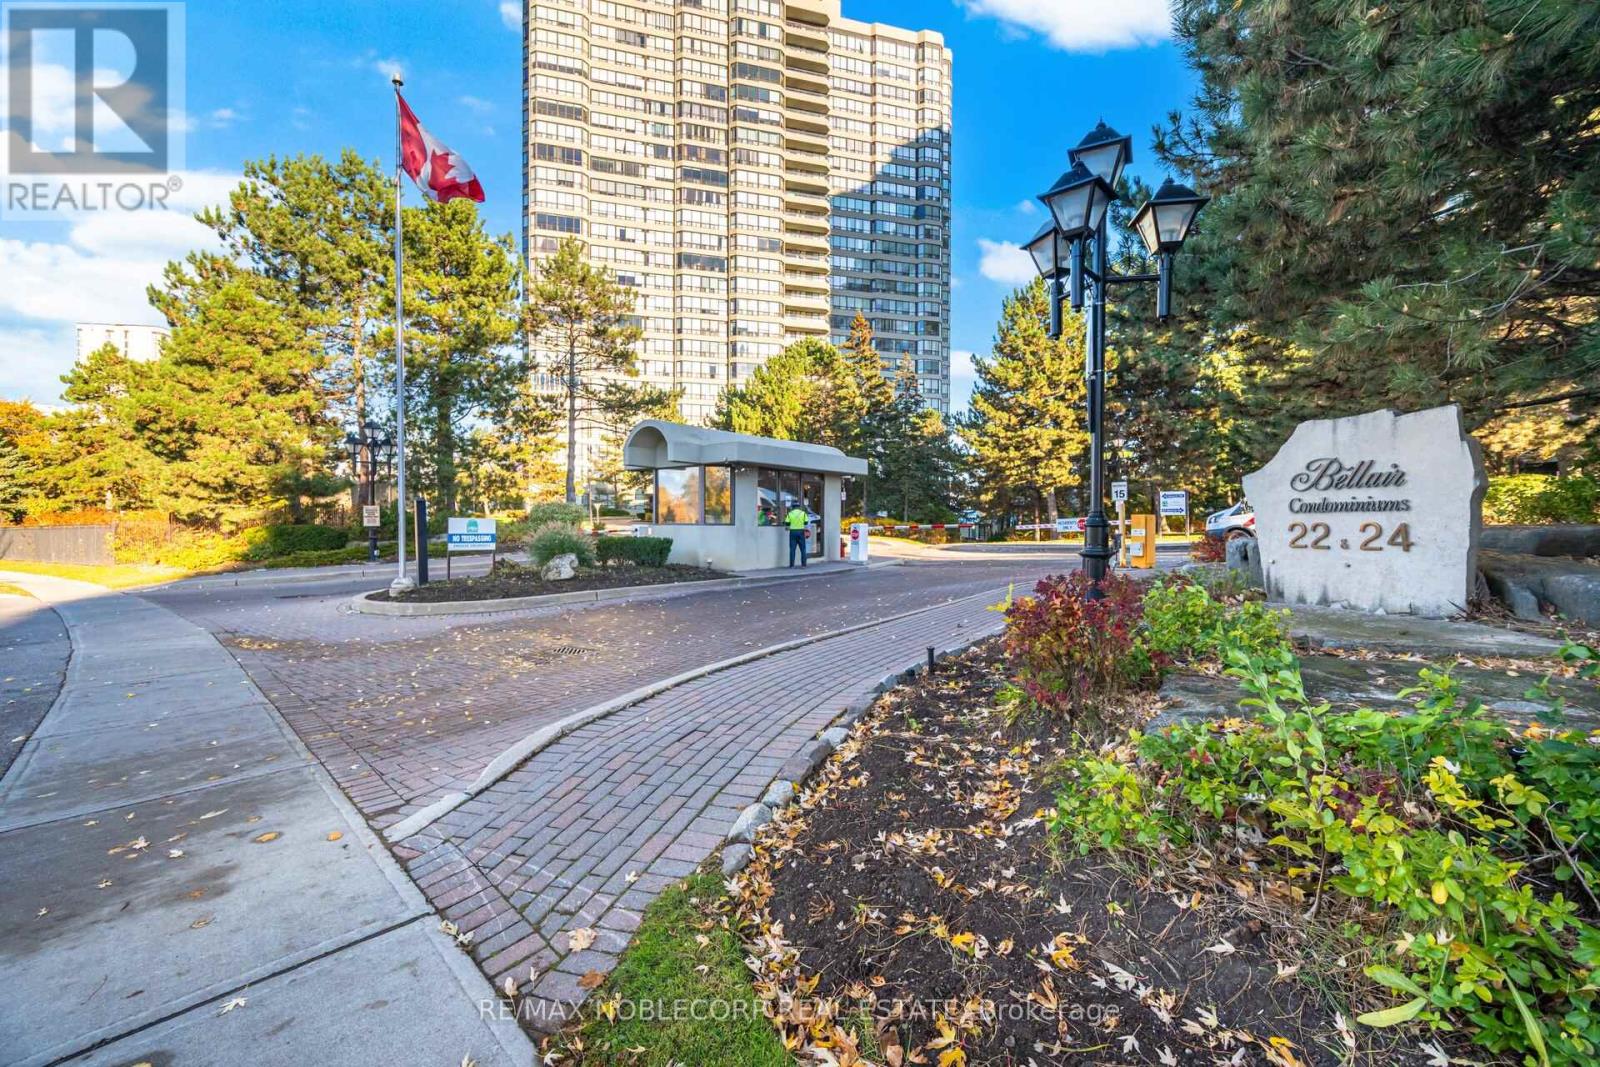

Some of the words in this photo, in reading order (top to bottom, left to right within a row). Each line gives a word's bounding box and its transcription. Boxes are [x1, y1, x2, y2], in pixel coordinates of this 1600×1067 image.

[1290, 457, 1408, 492] Bellair
[1114, 490, 1126, 498] 15
[1289, 496, 1412, 514] Condominiums
[1288, 521, 1331, 550] 22
[1340, 538, 1350, 550] &
[1359, 521, 1415, 552] 24
